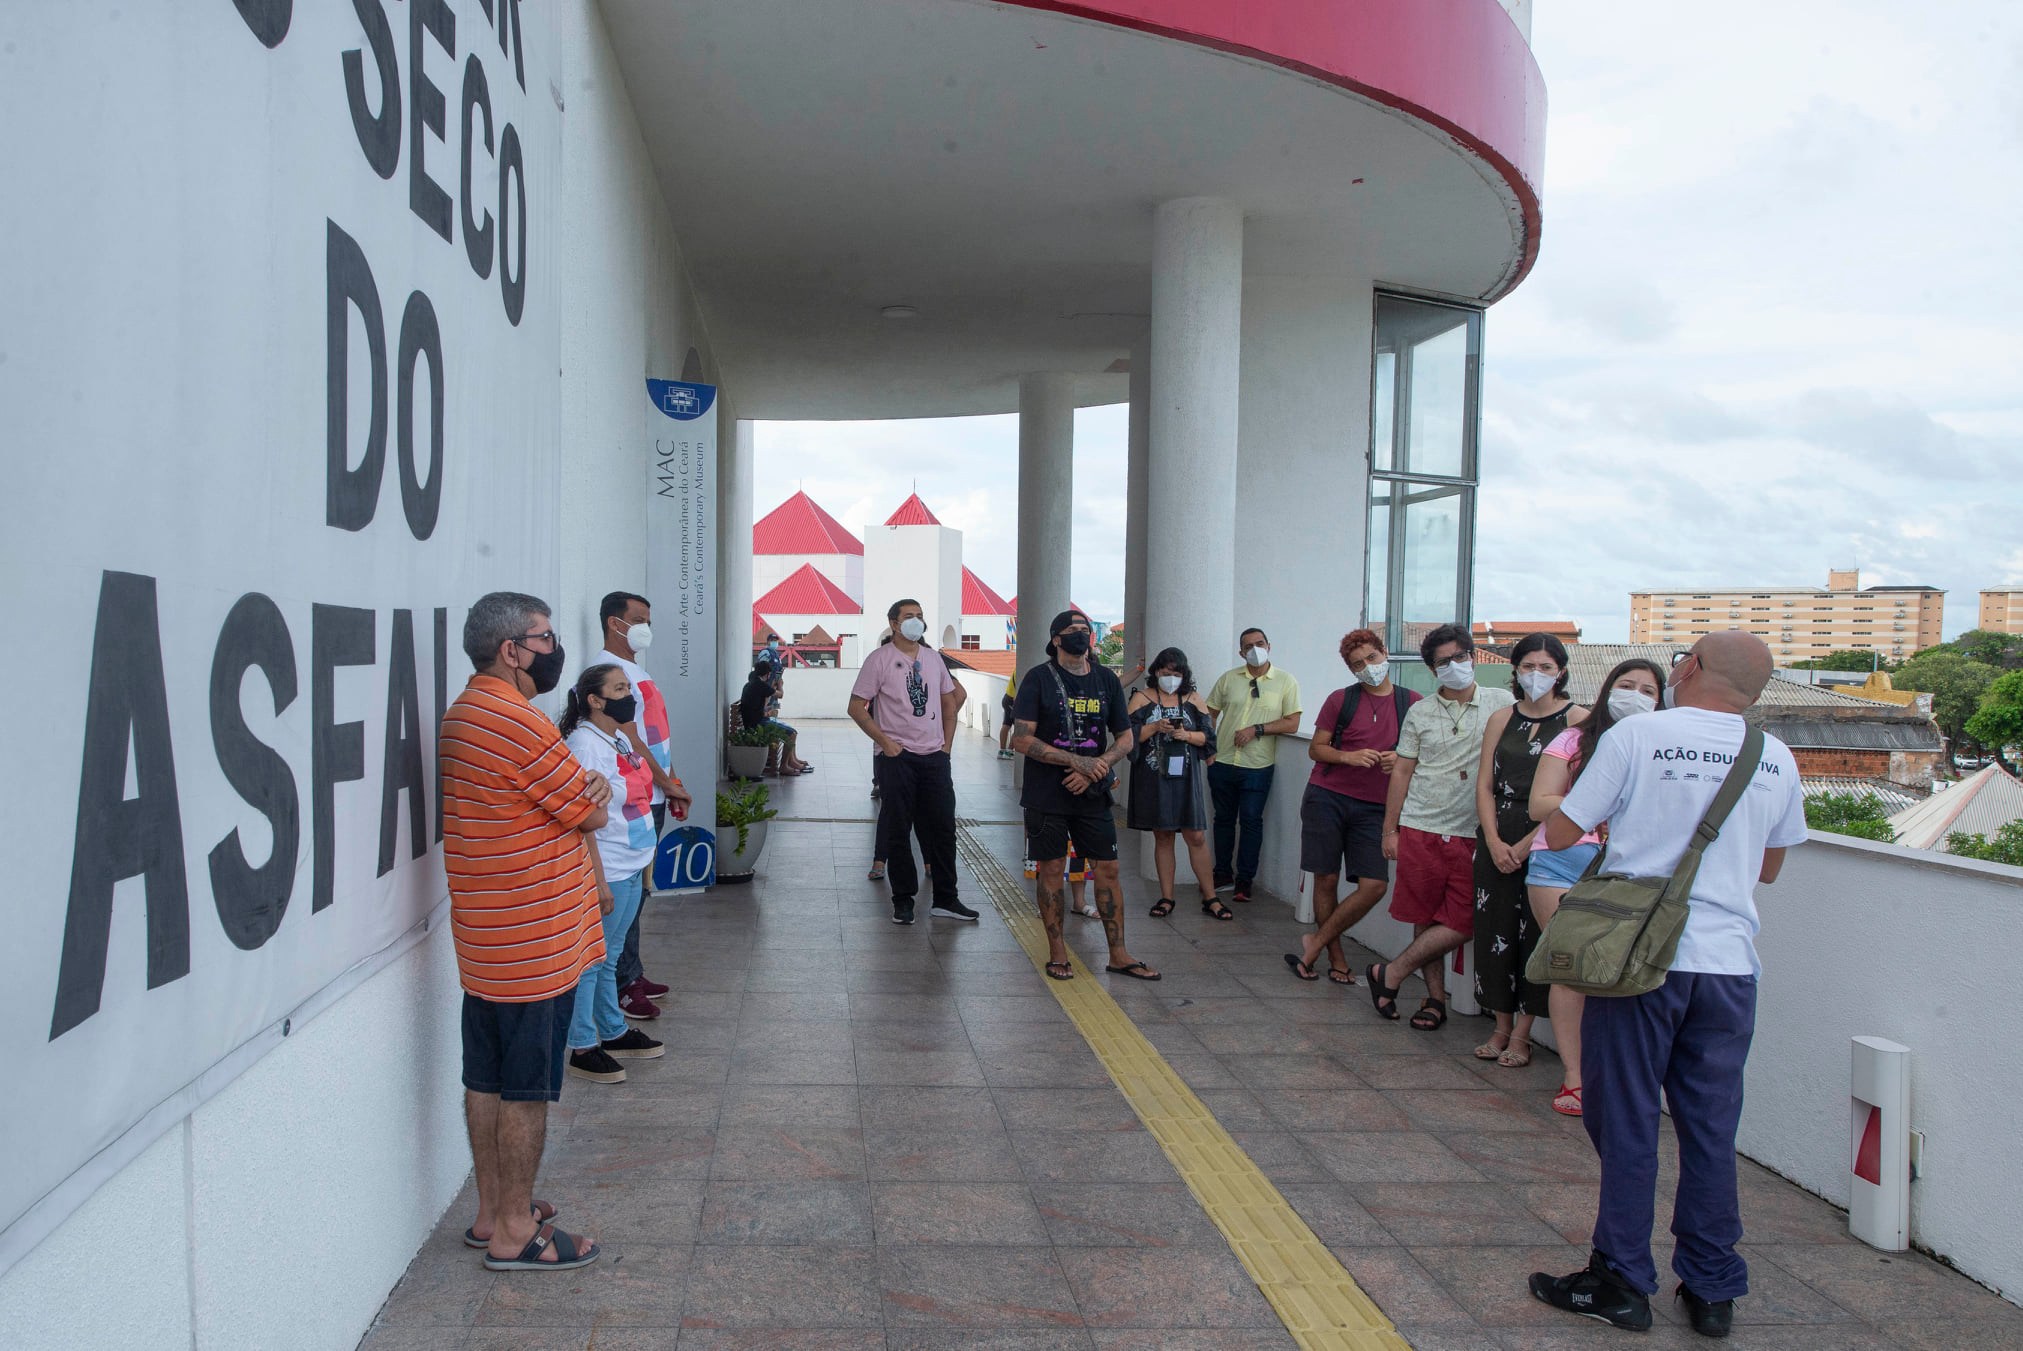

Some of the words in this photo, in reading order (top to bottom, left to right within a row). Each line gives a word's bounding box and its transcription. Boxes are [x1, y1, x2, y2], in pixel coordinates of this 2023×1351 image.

[341, 0, 526, 327] SECO
[326, 216, 444, 541] DO
[656, 439, 675, 498] MAC
[678, 441, 689, 475] Ceará
[694, 442, 704, 490] Museum
[678, 478, 689, 494] do
[678, 497, 692, 590] Contemporânea
[694, 493, 707, 572] Contemporary
[678, 620, 689, 636] de
[679, 593, 689, 618] Arte
[679, 639, 689, 677] Museu
[1653, 746, 1698, 762] AÇÃO
[1703, 751, 1780, 776] EDUIVA
[49, 569, 472, 1043] ASFAL
[666, 841, 713, 884] 10
